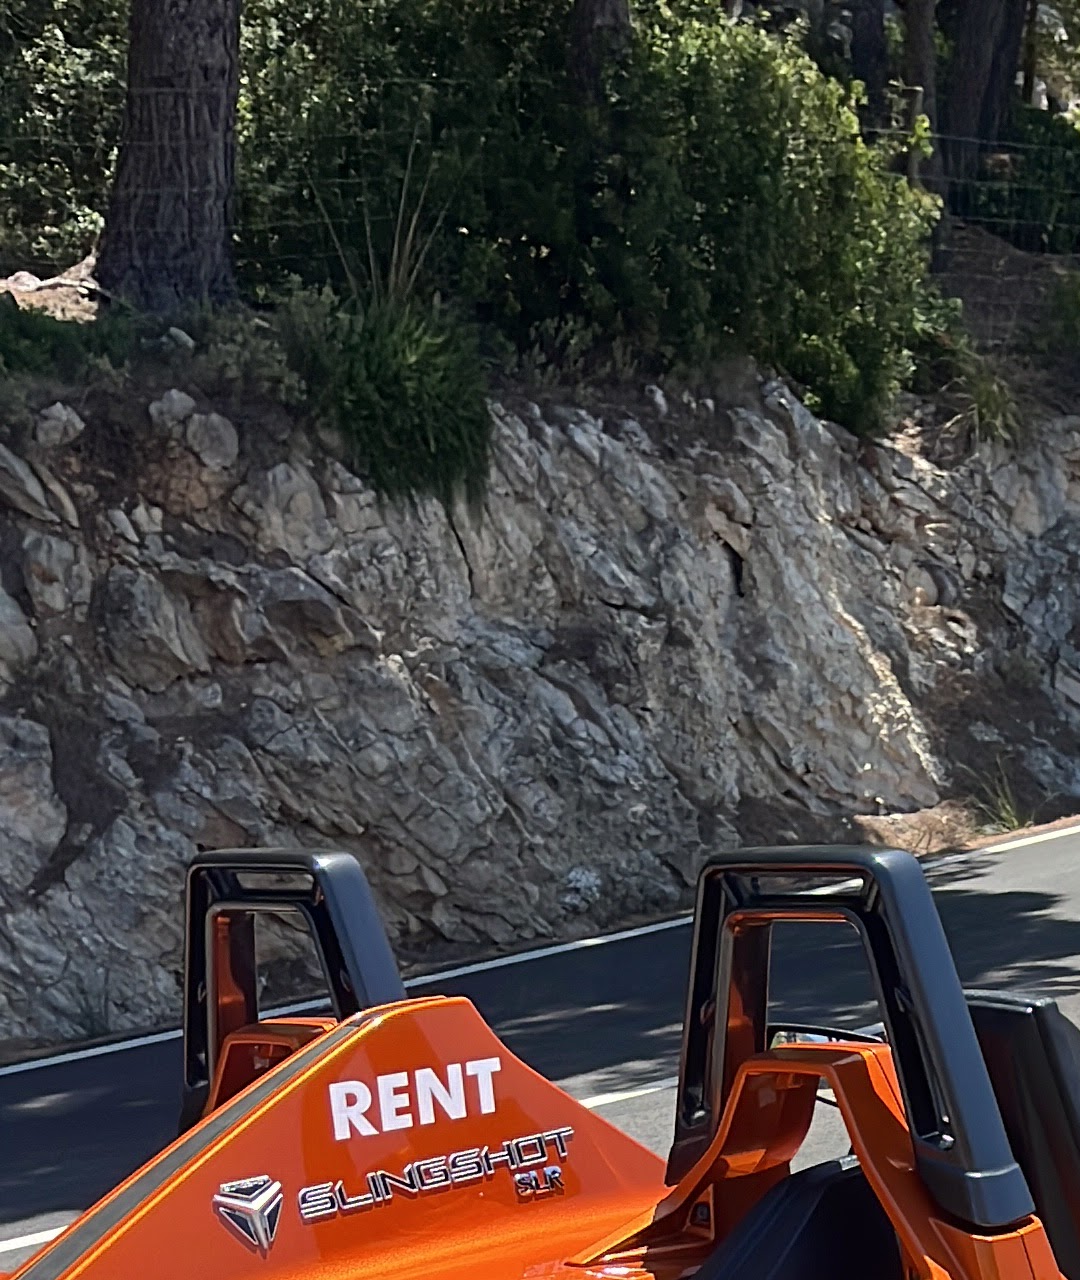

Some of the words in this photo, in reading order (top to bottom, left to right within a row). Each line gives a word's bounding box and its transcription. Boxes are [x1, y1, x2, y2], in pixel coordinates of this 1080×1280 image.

[329, 1057, 501, 1140] RENT
[300, 1127, 573, 1219] SLINGSHOT
[514, 1165, 564, 1196] SLR
